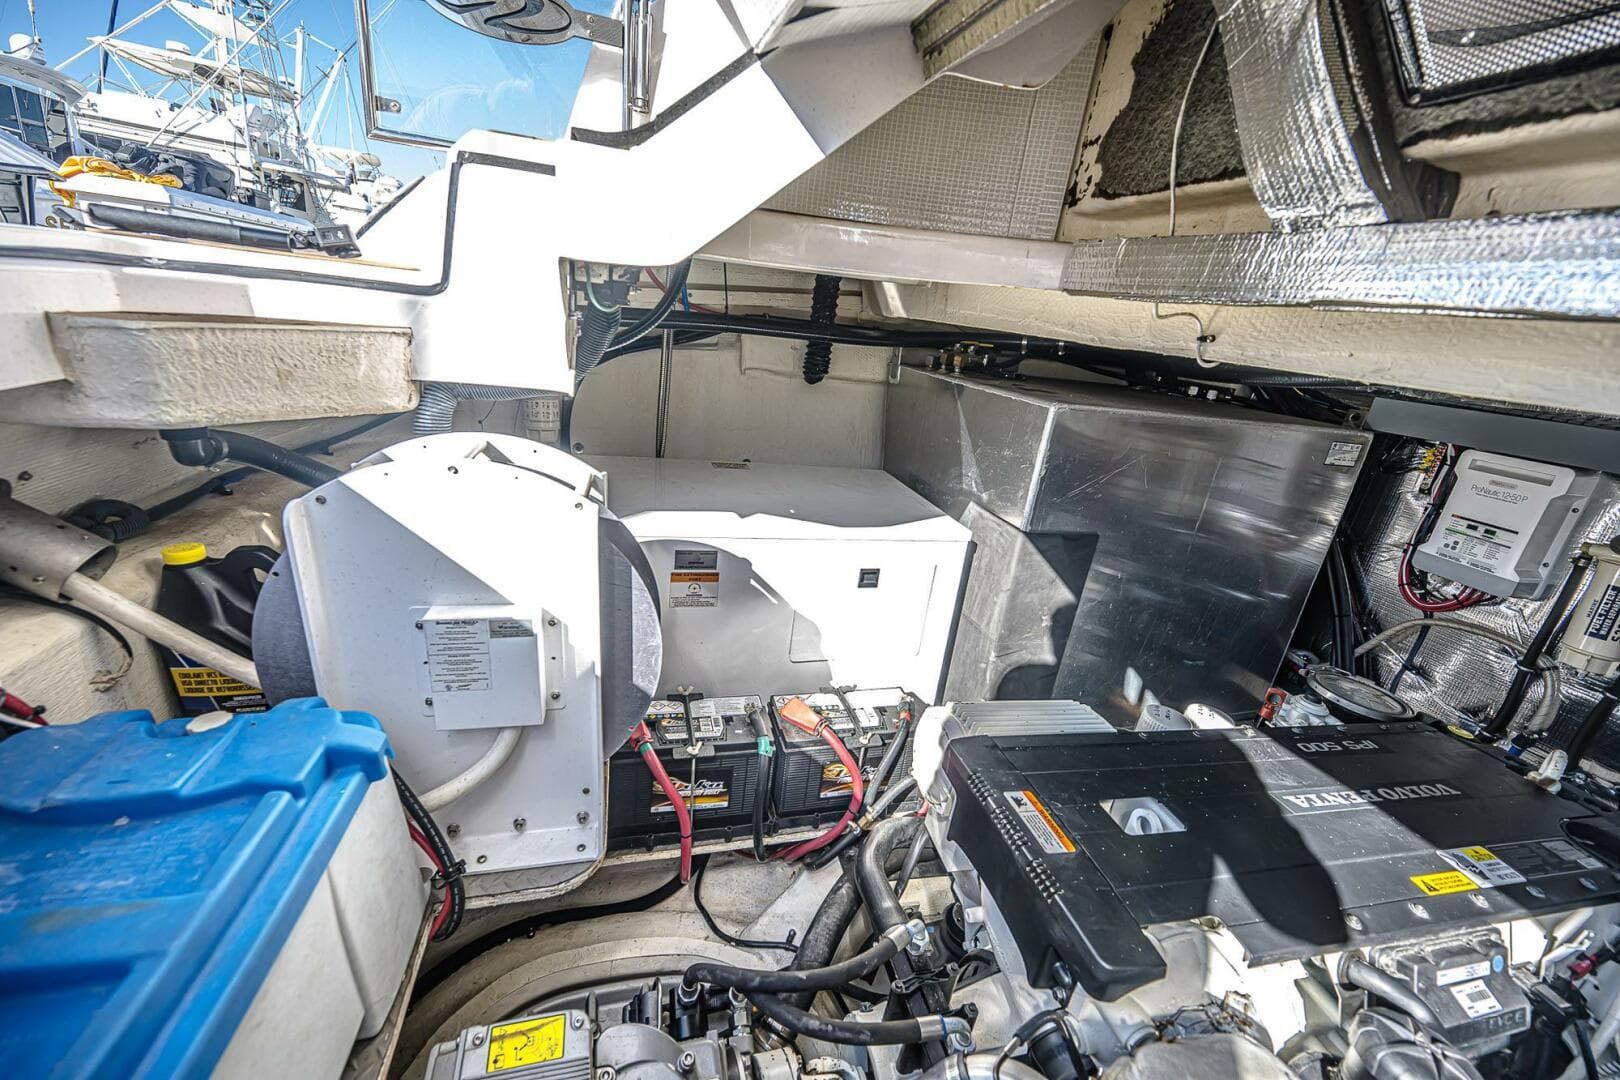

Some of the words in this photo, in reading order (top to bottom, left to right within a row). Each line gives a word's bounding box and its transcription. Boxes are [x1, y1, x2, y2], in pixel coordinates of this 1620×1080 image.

[1591, 613, 1606, 633] FUEL
[1601, 590, 1617, 614] FILTER
[1296, 741, 1342, 752] 500
[1342, 740, 1380, 750] IPS
[1283, 789, 1384, 808] PENTA
[1380, 783, 1462, 801] VOLVO
